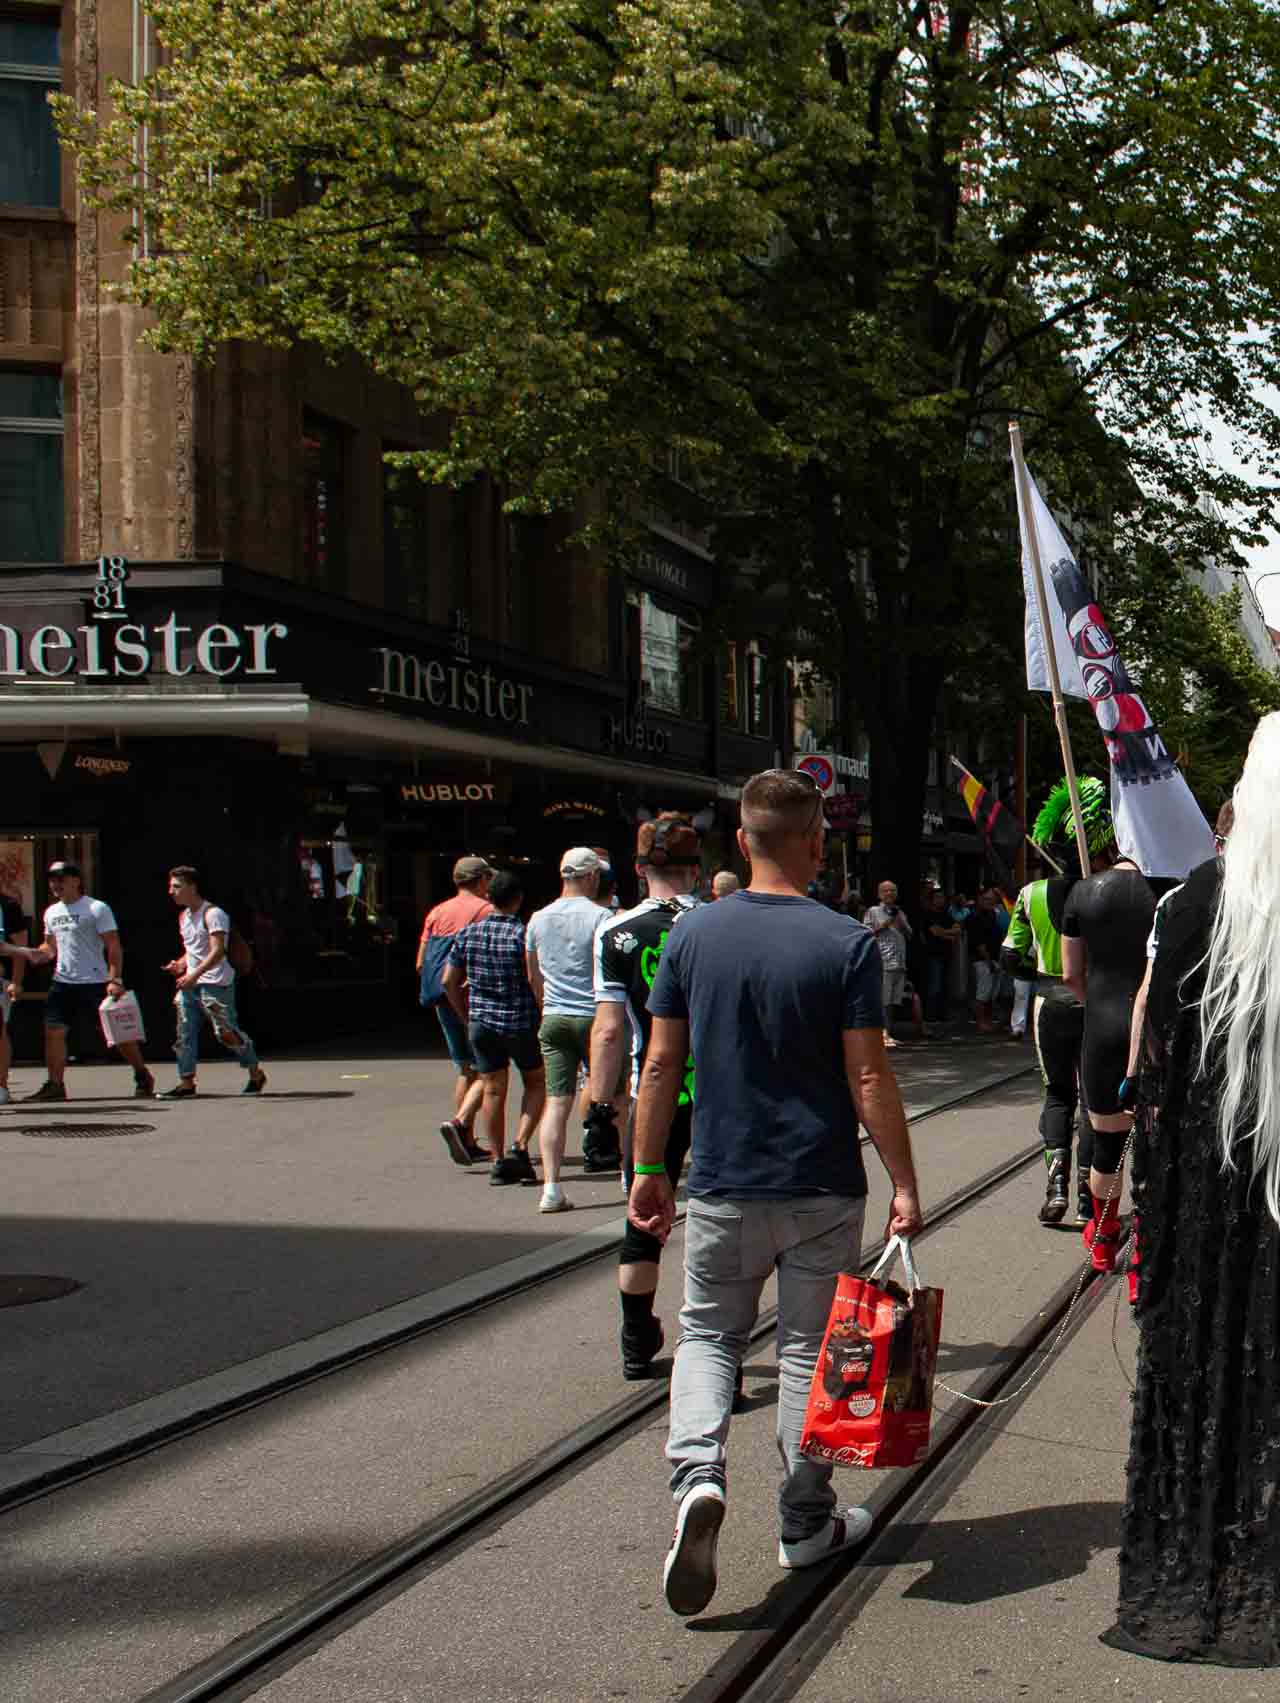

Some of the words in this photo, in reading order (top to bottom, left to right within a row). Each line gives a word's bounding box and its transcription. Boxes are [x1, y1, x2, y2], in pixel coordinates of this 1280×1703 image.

[97, 556, 128, 580] 18
[92, 581, 126, 609] 81
[369, 647, 535, 726] meister
[401, 784, 496, 801] HUBLOT
